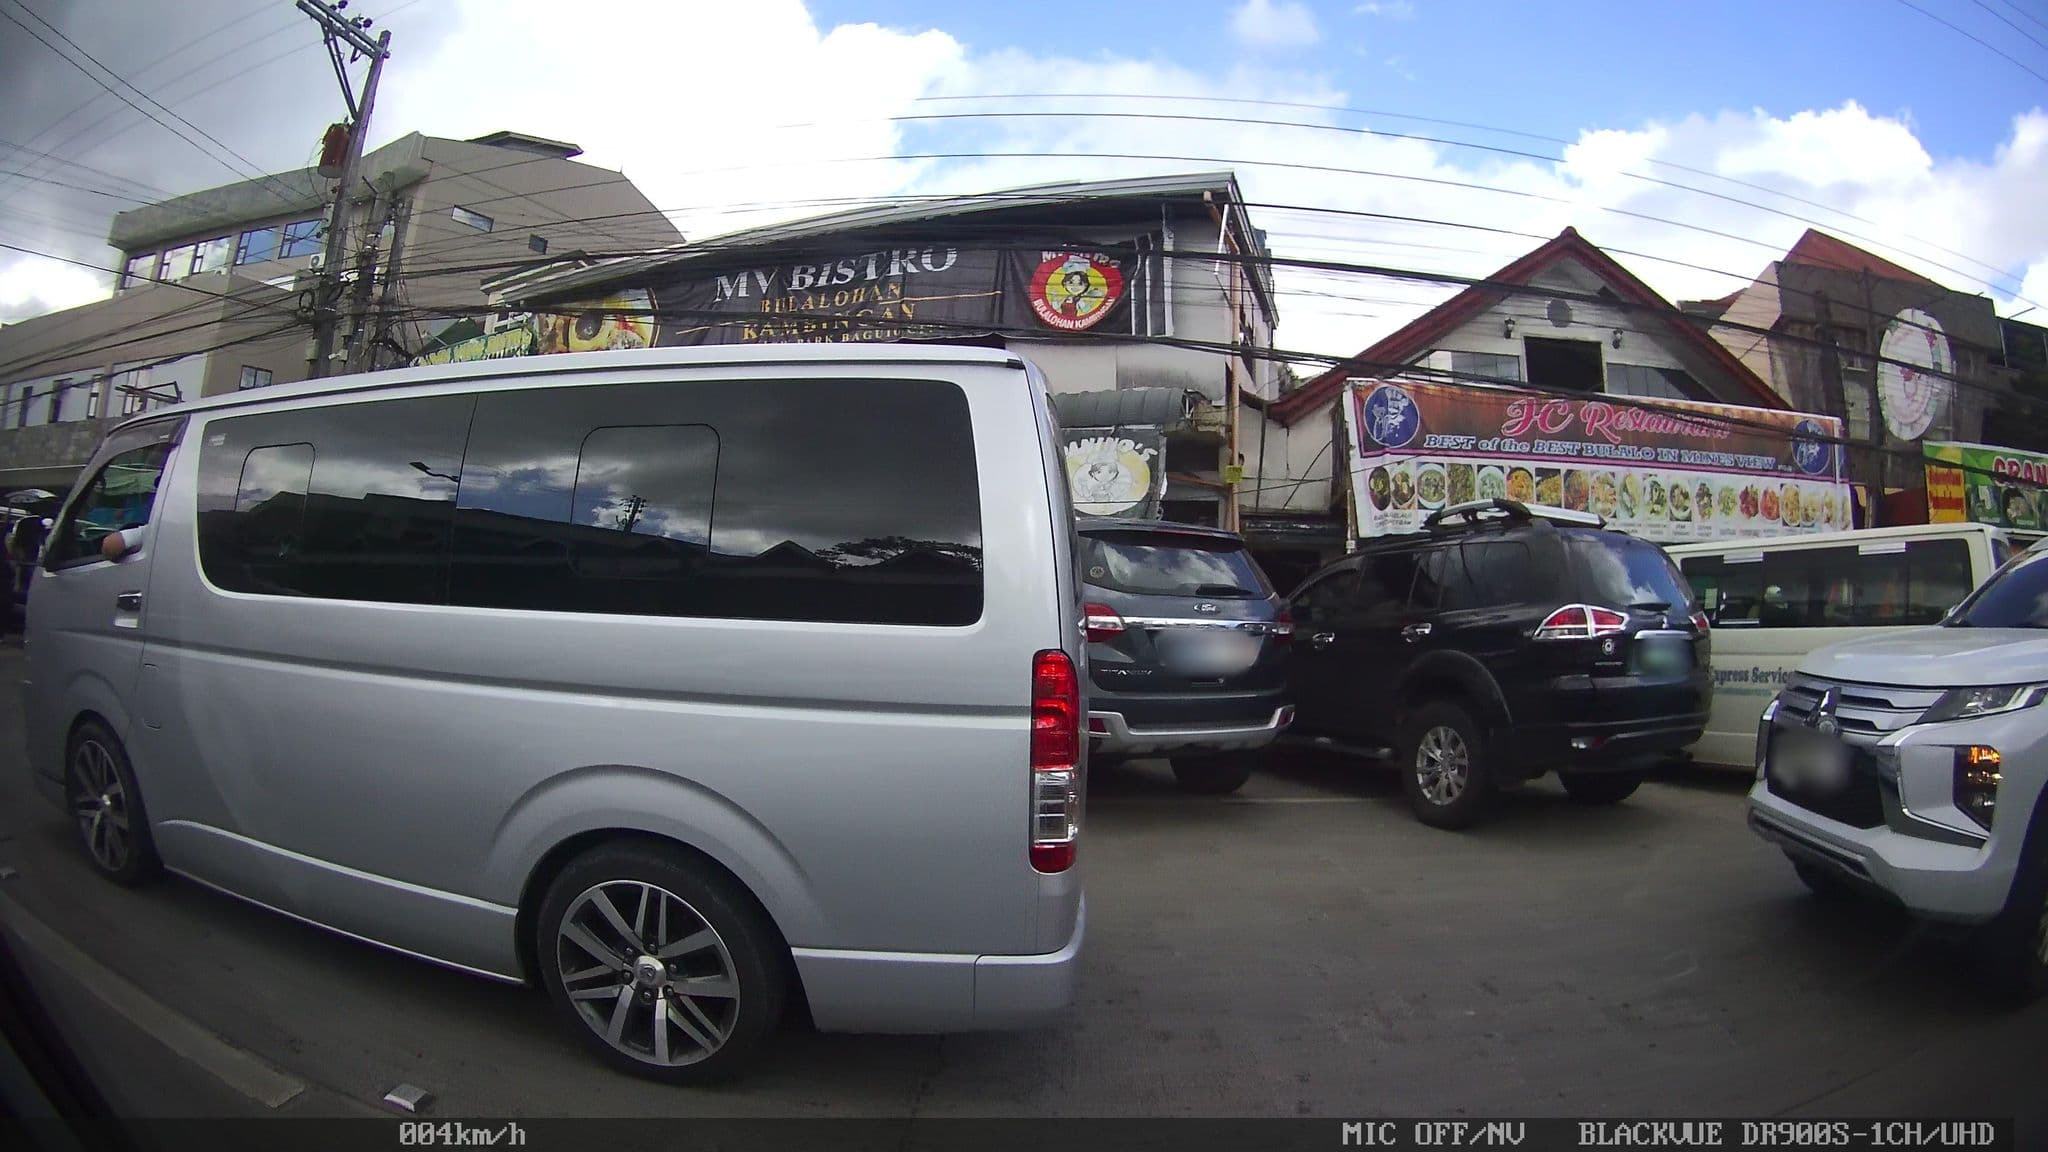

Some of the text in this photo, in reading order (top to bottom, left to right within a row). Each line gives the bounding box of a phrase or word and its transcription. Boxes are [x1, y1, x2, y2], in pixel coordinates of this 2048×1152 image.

[787, 247, 957, 291] BISTRO
[760, 282, 902, 313] BULALOHAN
[1424, 434, 1476, 450] BEST
[1478, 437, 1500, 451] of
[1500, 437, 1530, 453] the
[1532, 439, 1581, 456] BEST
[1582, 442, 1655, 461] BULALO
[1657, 447, 1679, 464] IN
[1680, 449, 1735, 468] MINES
[1735, 453, 1776, 471] VIEW
